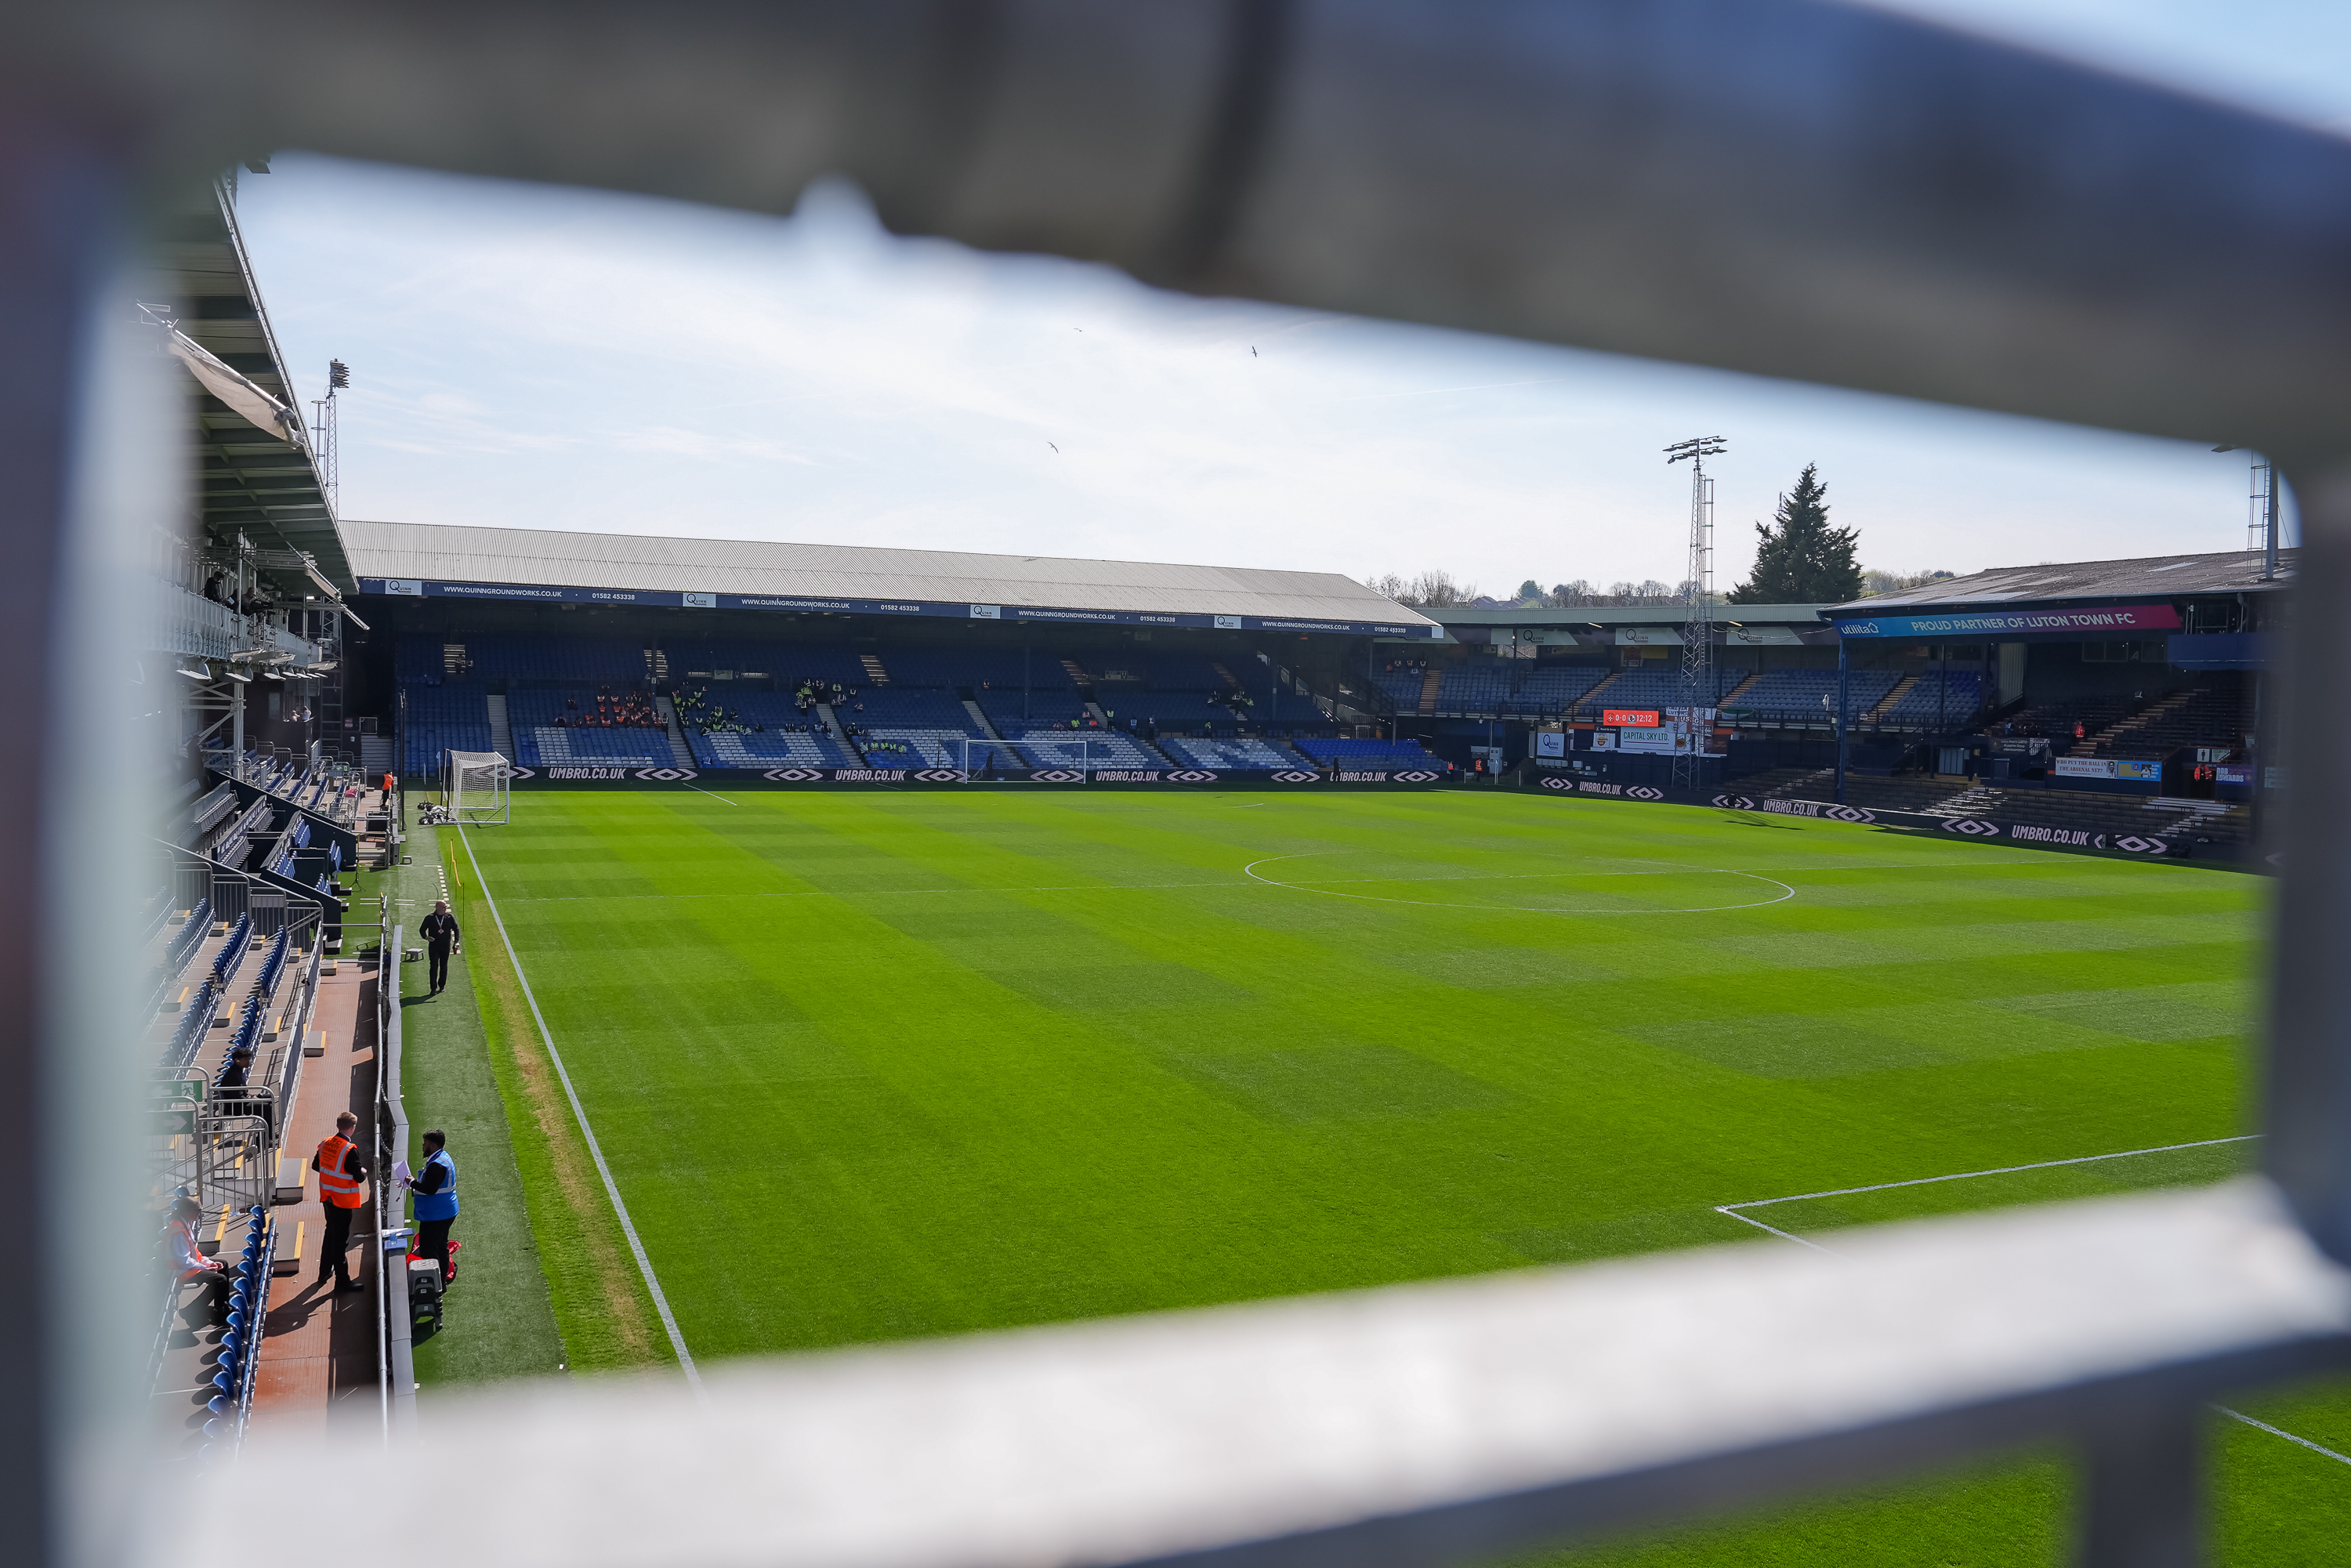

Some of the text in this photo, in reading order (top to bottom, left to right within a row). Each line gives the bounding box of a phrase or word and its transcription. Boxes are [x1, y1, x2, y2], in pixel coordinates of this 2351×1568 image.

[389, 580, 411, 592] QUINN
[444, 586, 562, 597] WWW.QUINNGROUNDWORKS.CO.UK
[686, 593, 707, 605] QUINN
[741, 599, 850, 610] WWW.QUINNGROUNDWORKS.CO.UK
[973, 605, 992, 617] QUINN
[1018, 610, 1116, 621] WWW.QUINNGROUNDWORKS.CO.UK
[1262, 621, 1350, 631] WWW.QUINNGROUNDWORKS.CO.UK
[1911, 612, 2135, 632] PROUD PARTNER OF LUTON TOWN FC
[1625, 628, 1649, 642] QUINN
[1841, 623, 1870, 636] utilita
[1523, 629, 1544, 643] QUINN
[549, 766, 625, 780] UMBRO.CO.UK
[835, 770, 905, 782] UMBRO.CO.UK
[1096, 770, 1159, 782] UMBRO.CO.UK
[1579, 781, 1621, 795] UMBRO.CO.UK
[1762, 799, 1819, 817] UMBRO.CO.UK
[2012, 824, 2090, 846] UMBRO.CO.UK
